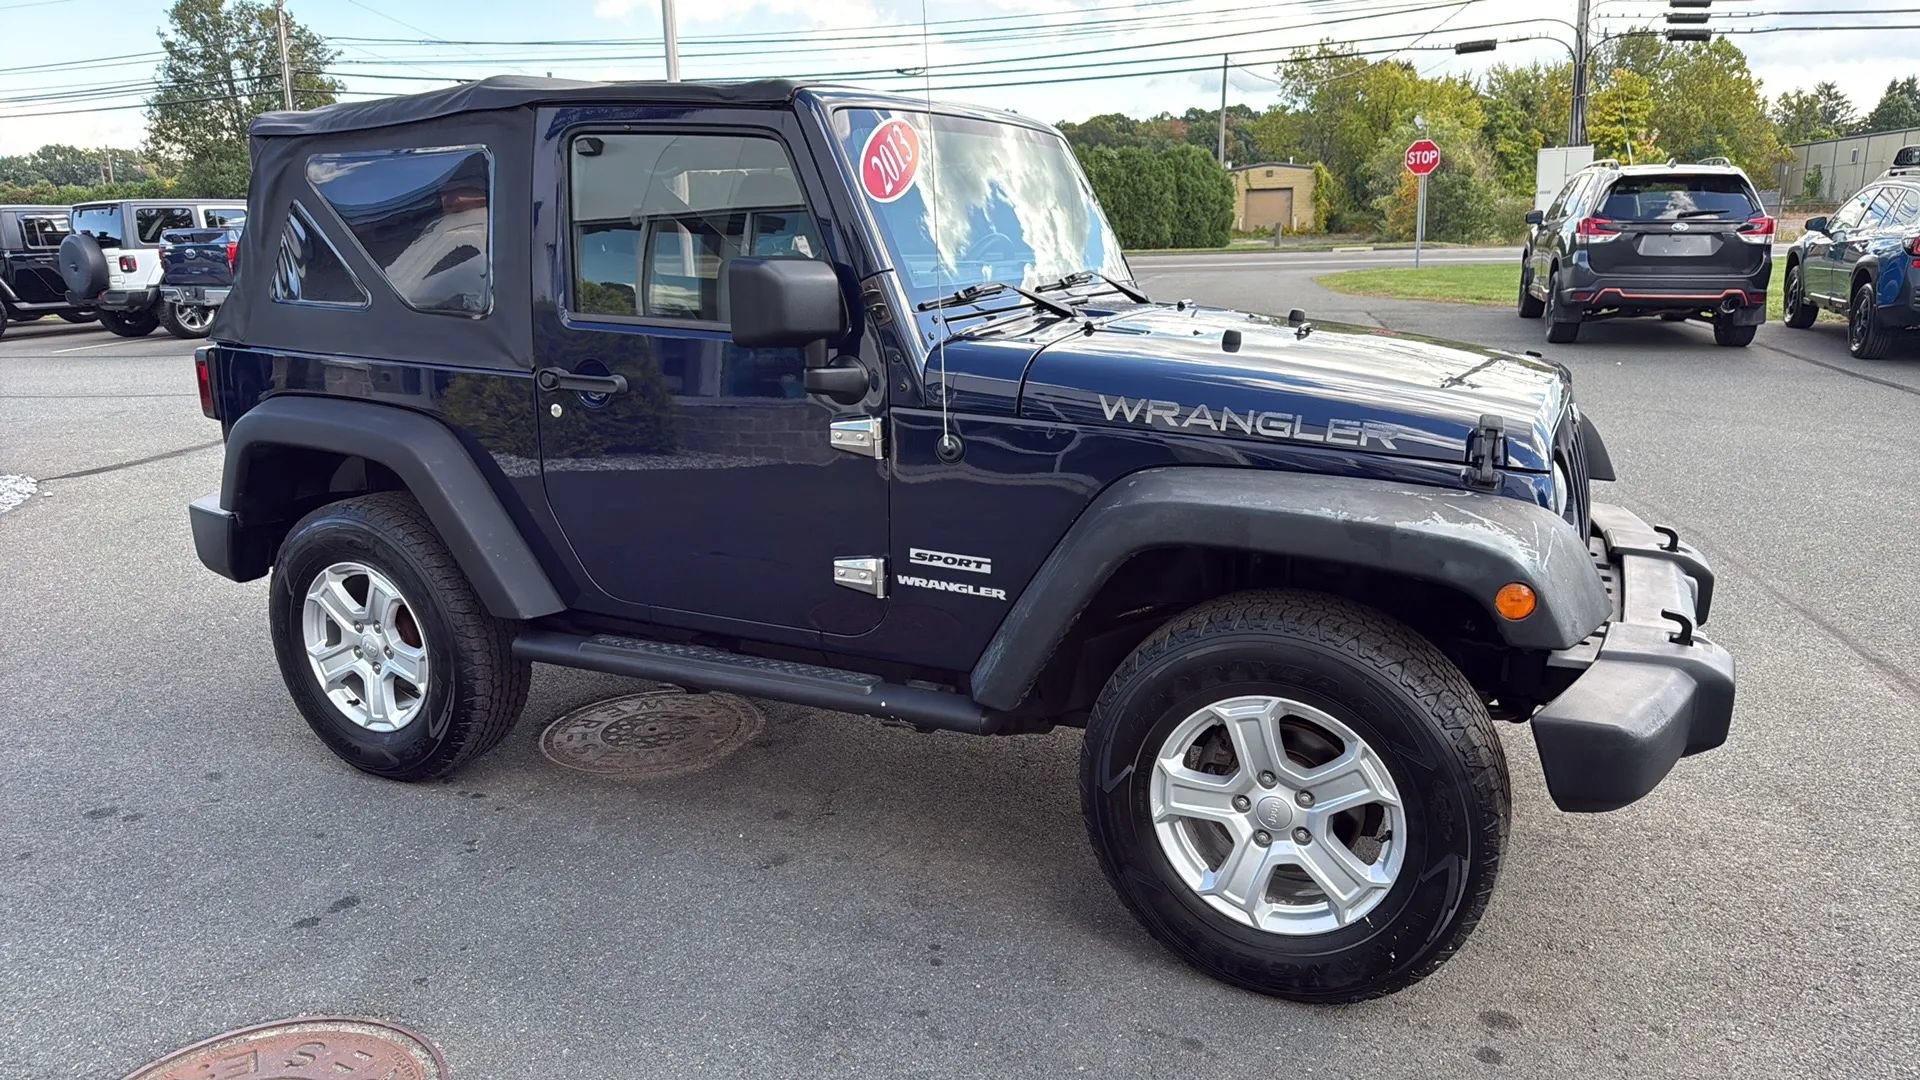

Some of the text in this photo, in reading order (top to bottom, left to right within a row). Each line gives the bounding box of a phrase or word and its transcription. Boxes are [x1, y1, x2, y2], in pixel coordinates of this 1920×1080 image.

[871, 125, 913, 195] 2013
[1408, 150, 1438, 165] STOP
[1099, 394, 1398, 450] WRANGLER
[911, 551, 990, 570] SPORT
[897, 575, 1007, 600] WRANGLER
